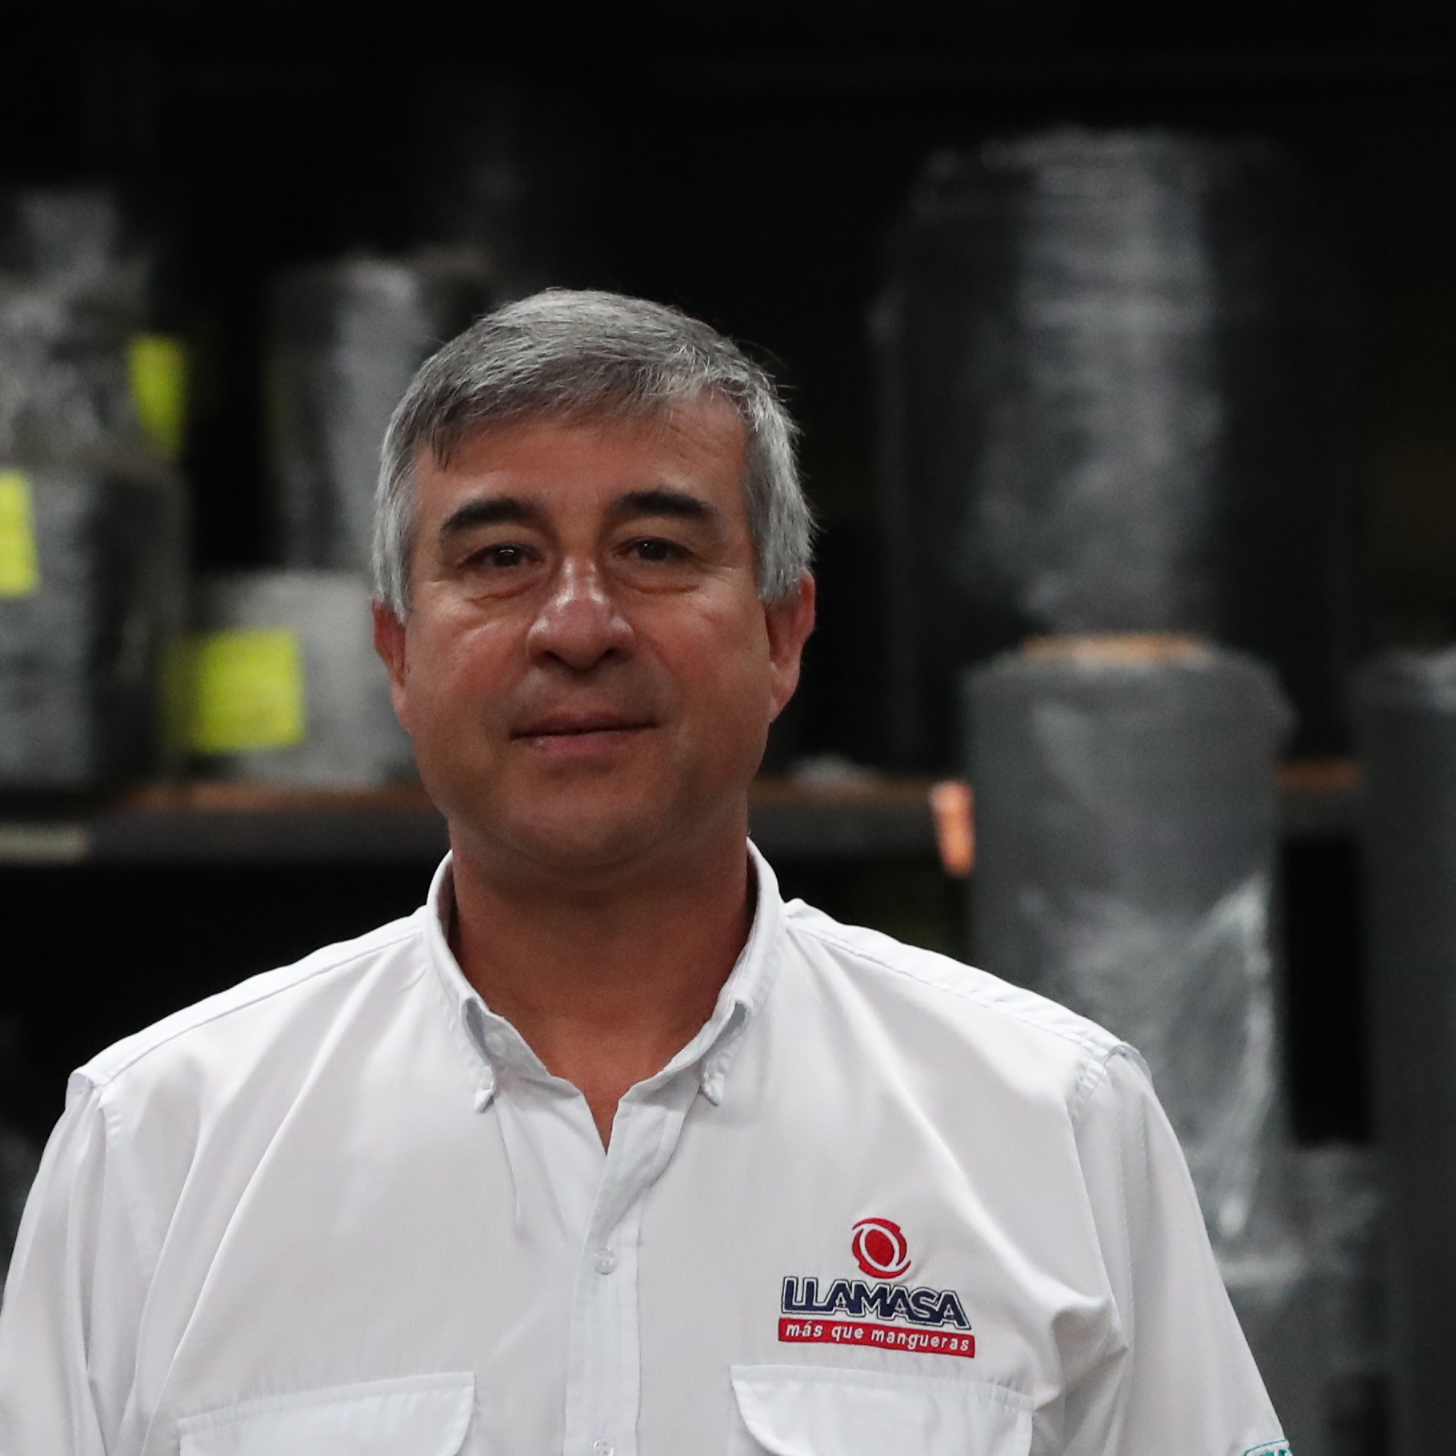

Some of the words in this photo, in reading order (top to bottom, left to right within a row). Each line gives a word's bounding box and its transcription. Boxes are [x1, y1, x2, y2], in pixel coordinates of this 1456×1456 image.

[781, 1276, 971, 1330] LLAMASA
[786, 1321, 823, 1337] más
[831, 1325, 865, 1341] que
[871, 1329, 969, 1351] mangueras
